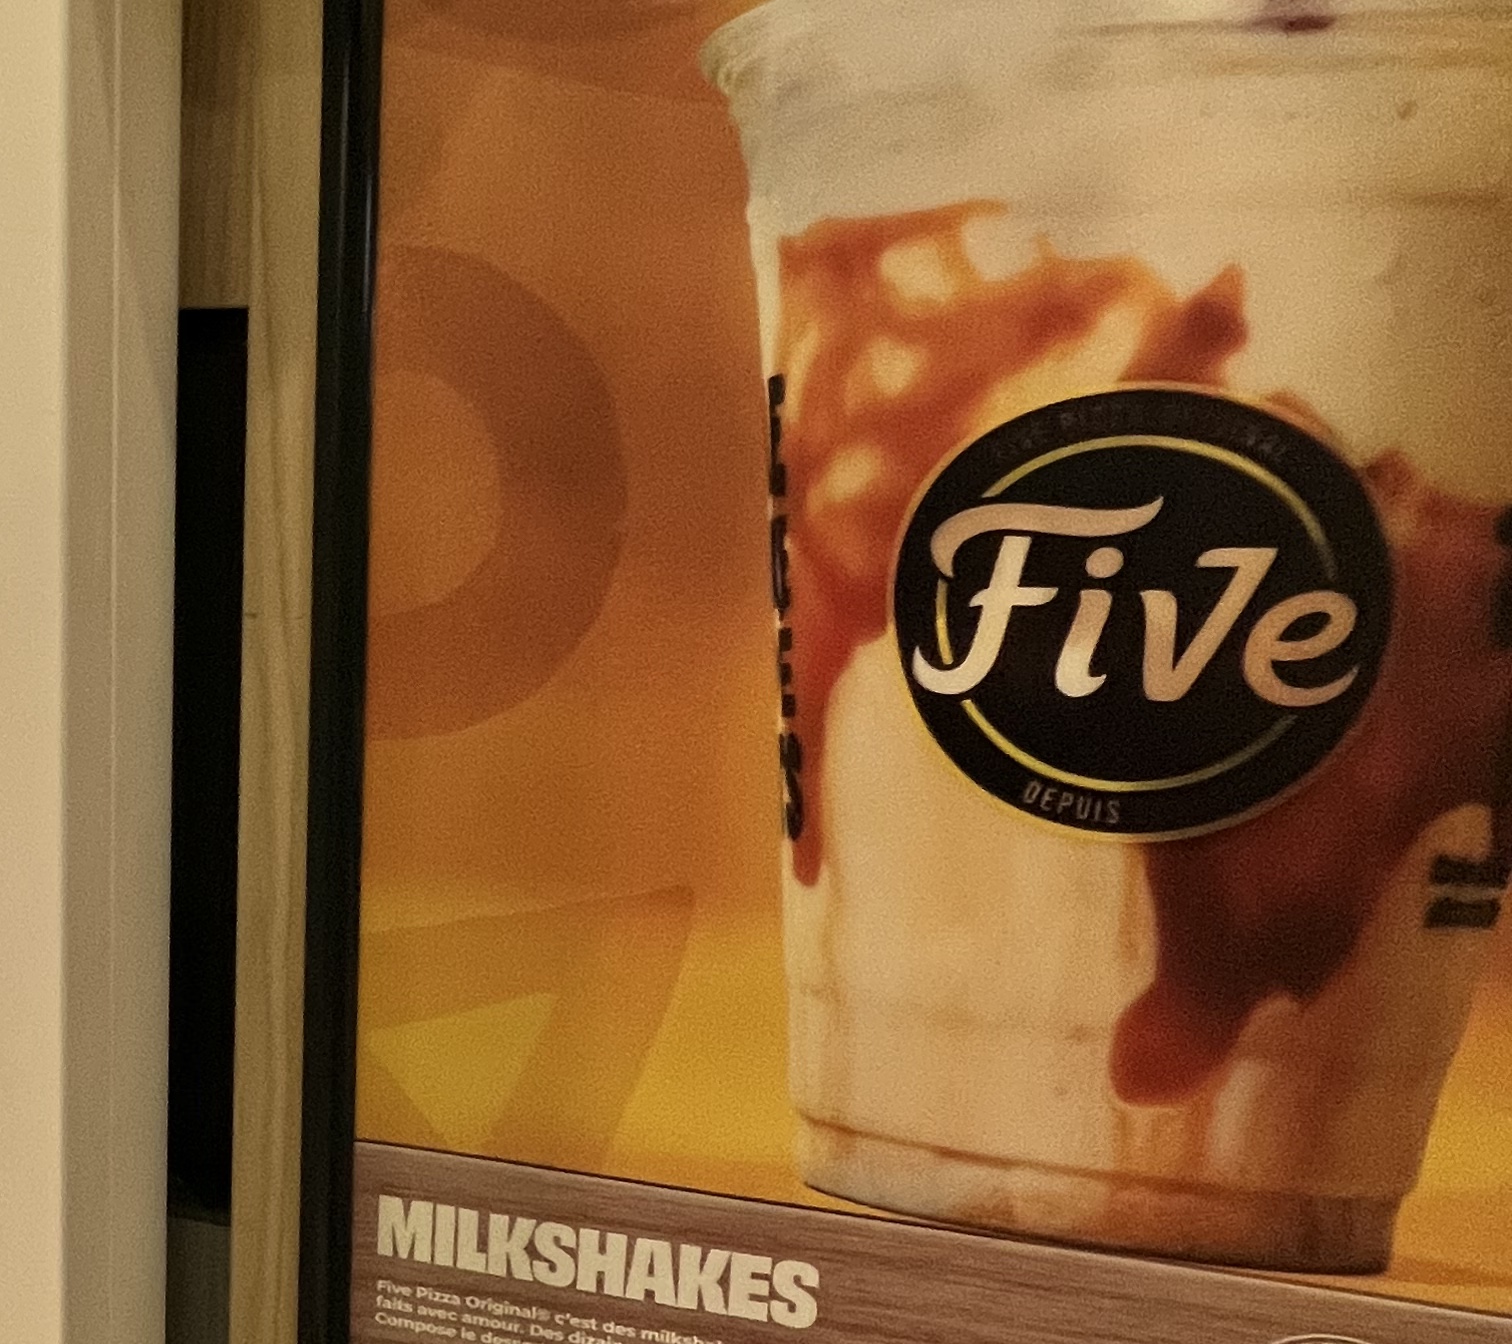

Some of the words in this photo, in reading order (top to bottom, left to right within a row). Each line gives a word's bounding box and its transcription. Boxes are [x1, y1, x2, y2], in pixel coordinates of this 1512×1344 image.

[911, 494, 1360, 707] Five
[1021, 779, 1123, 826] DEPUIS
[376, 1194, 821, 1330] MILKSHAKES
[375, 1311, 457, 1338] Compose
[461, 1326, 477, 1342] le
[376, 1279, 413, 1298] Five
[416, 1286, 461, 1306] Pizza
[554, 1312, 598, 1331] c'est
[603, 1320, 636, 1339] des
[376, 1294, 413, 1314] faits
[417, 1305, 458, 1323] avec
[462, 1313, 525, 1334] amour.
[530, 1323, 565, 1342] Des
